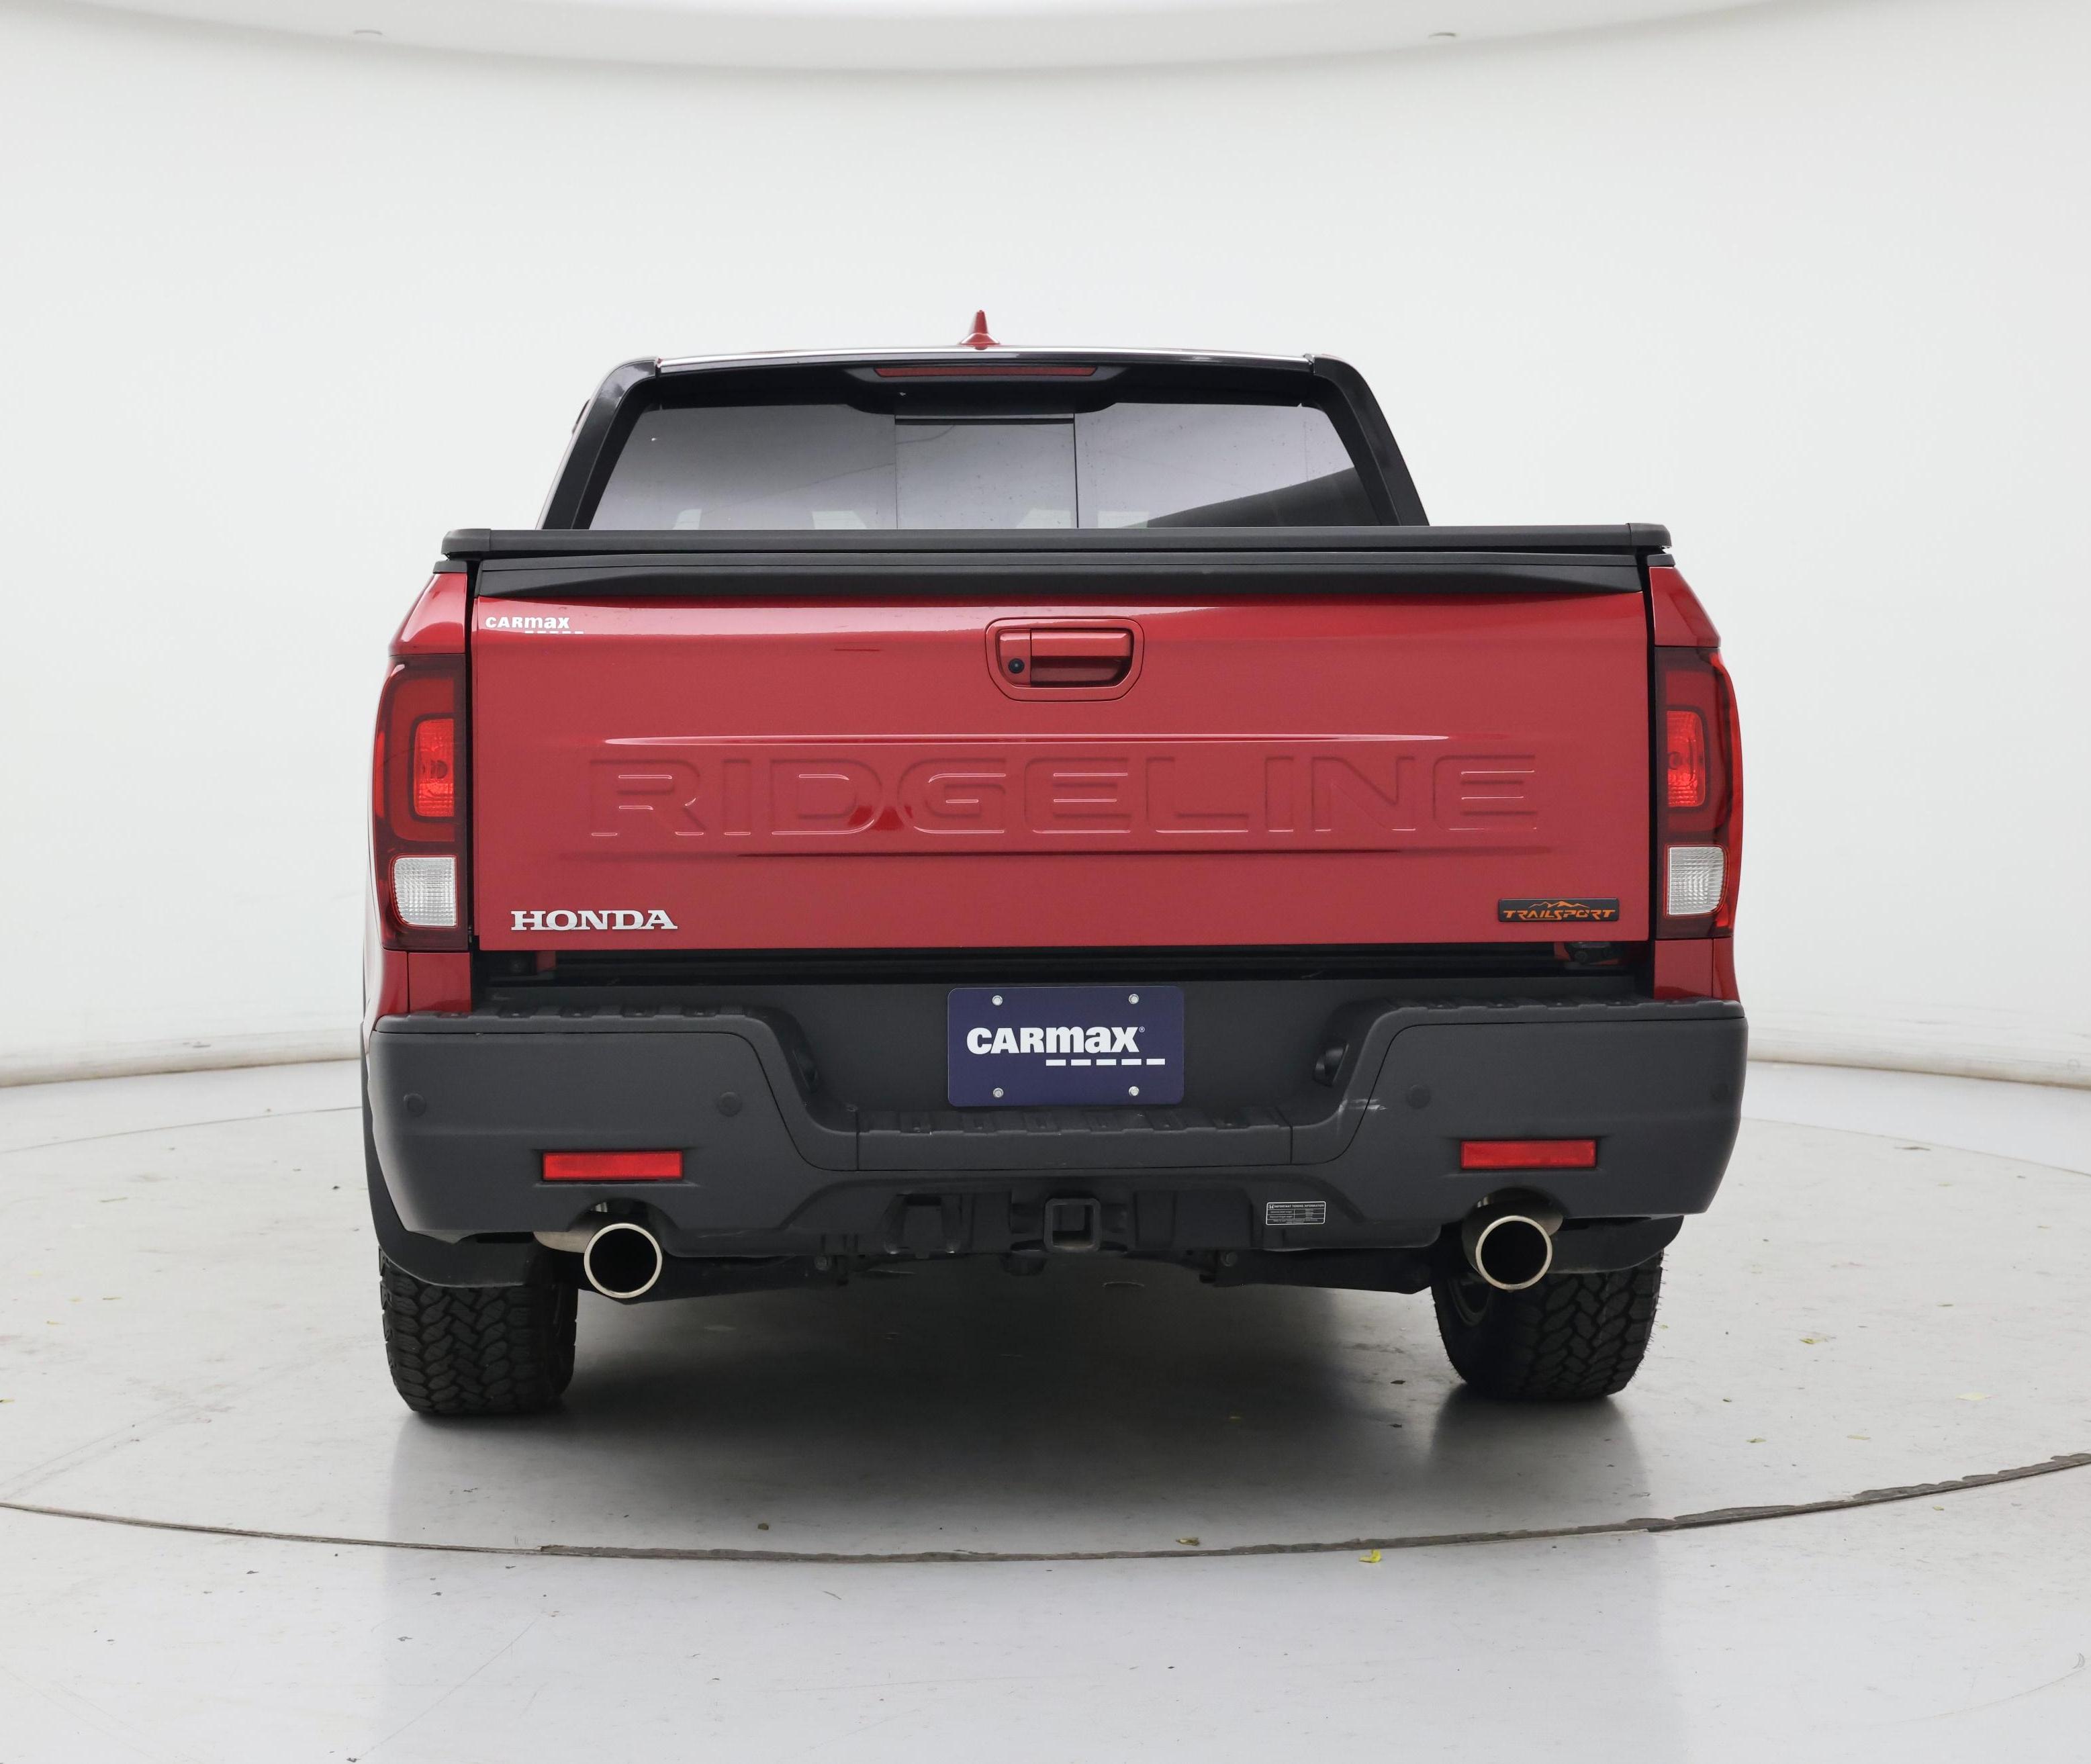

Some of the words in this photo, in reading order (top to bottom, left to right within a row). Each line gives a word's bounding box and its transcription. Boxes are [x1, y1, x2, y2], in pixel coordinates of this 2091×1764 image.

[589, 755, 1537, 837] RIDGELINE
[510, 909, 678, 931] HONDA
[1503, 910, 1616, 920] TRAILSPORT
